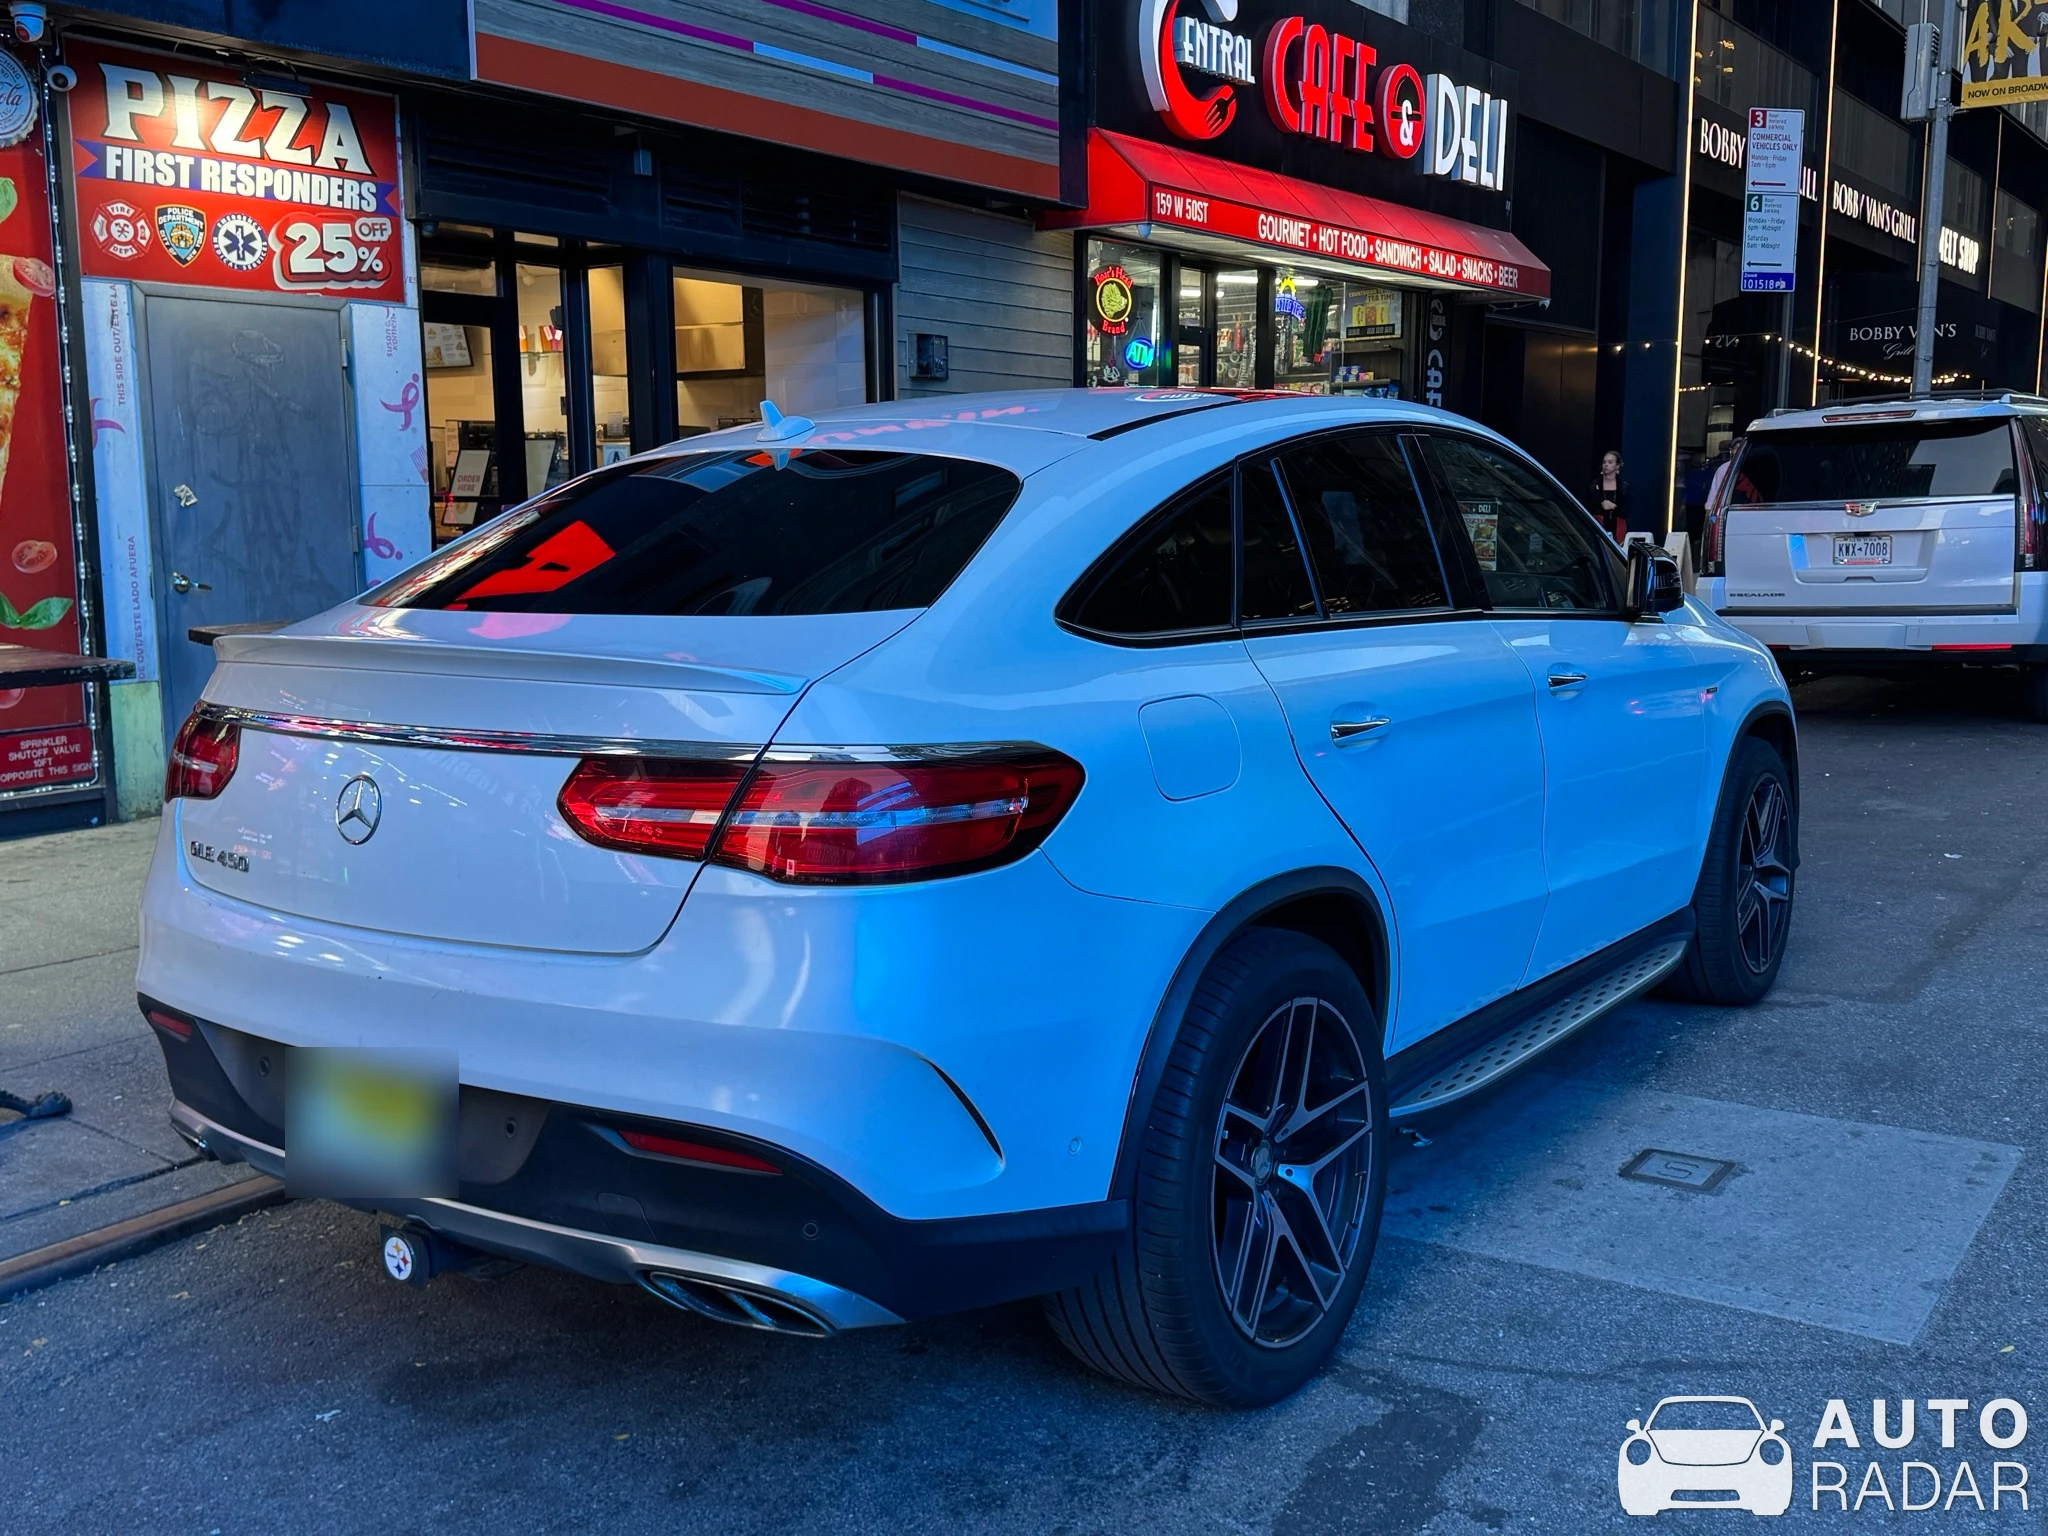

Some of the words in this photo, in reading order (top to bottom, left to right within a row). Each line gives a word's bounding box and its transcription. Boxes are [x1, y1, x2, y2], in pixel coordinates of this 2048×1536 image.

[1963, 0, 2048, 68] AR
[1968, 89, 1990, 99] NOW
[1992, 88, 2005, 96] ON
[1263, 16, 1376, 152] CAFE
[1423, 74, 1508, 191] DELI
[99, 62, 377, 177] PIZZA
[1754, 111, 1764, 127] 3
[1700, 117, 1746, 169] BOBBY
[1752, 132, 1792, 142] COMMERCIAL
[1751, 142, 1781, 151] VEHICLES
[1782, 143, 1798, 151] ONLY
[1772, 154, 1787, 162] Friday
[105, 146, 195, 190] FIRST
[201, 158, 377, 213] RESPONDERS
[110, 204, 132, 215] FIRE
[167, 206, 194, 217] POLICE
[1156, 192, 1172, 216] 159
[1174, 196, 1183, 219] W
[1186, 198, 1209, 224] 50ST
[1750, 195, 1759, 211] 6
[158, 214, 204, 230] DEPARTMENT
[216, 213, 262, 232] EMERGENCY
[1865, 195, 1891, 233] VAN'S
[1892, 209, 1916, 244] GRILL
[358, 220, 390, 239] OFF
[1747, 234, 1769, 242] Saturday
[112, 246, 135, 255] DEPT
[212, 236, 239, 270] MEDICAL
[241, 240, 269, 272] SERVICES
[284, 222, 384, 275] 25%
[1258, 213, 1311, 248] GOURMET
[1318, 226, 1340, 253] HOT
[1341, 231, 1368, 259] FOOD
[1375, 239, 1422, 270] SANDWICH
[1428, 250, 1456, 277] SALAD
[1462, 257, 1493, 284] SNACKS
[1498, 265, 1518, 288] BEER
[1114, 265, 1135, 290] Head
[1743, 279, 1775, 290] 101518
[1367, 294, 1380, 302] TEA
[1381, 293, 1395, 301] TIME
[1101, 319, 1126, 335] Brand
[1850, 326, 1904, 341] BOBBY
[1908, 323, 1957, 339] VN'S
[1126, 341, 1155, 368] ATM
[1882, 342, 1916, 360] Grill
[115, 355, 124, 380] SIDE
[117, 381, 127, 407] THIS
[457, 474, 480, 483] ORDER
[457, 484, 475, 492] HERE
[1478, 504, 1491, 513] DELI
[128, 535, 138, 578] AFUERA
[1864, 541, 1888, 556] 7008
[131, 580, 142, 611] LADO
[20, 735, 68, 749] SPRINKLER
[8, 748, 49, 761] SHUTOFF
[53, 744, 81, 755] VALVE
[0, 769, 44, 782] OPPOSITE
[48, 765, 68, 776] THIS
[72, 762, 92, 773] SIGN
[190, 840, 215, 864] GLE
[217, 849, 250, 873] 450
